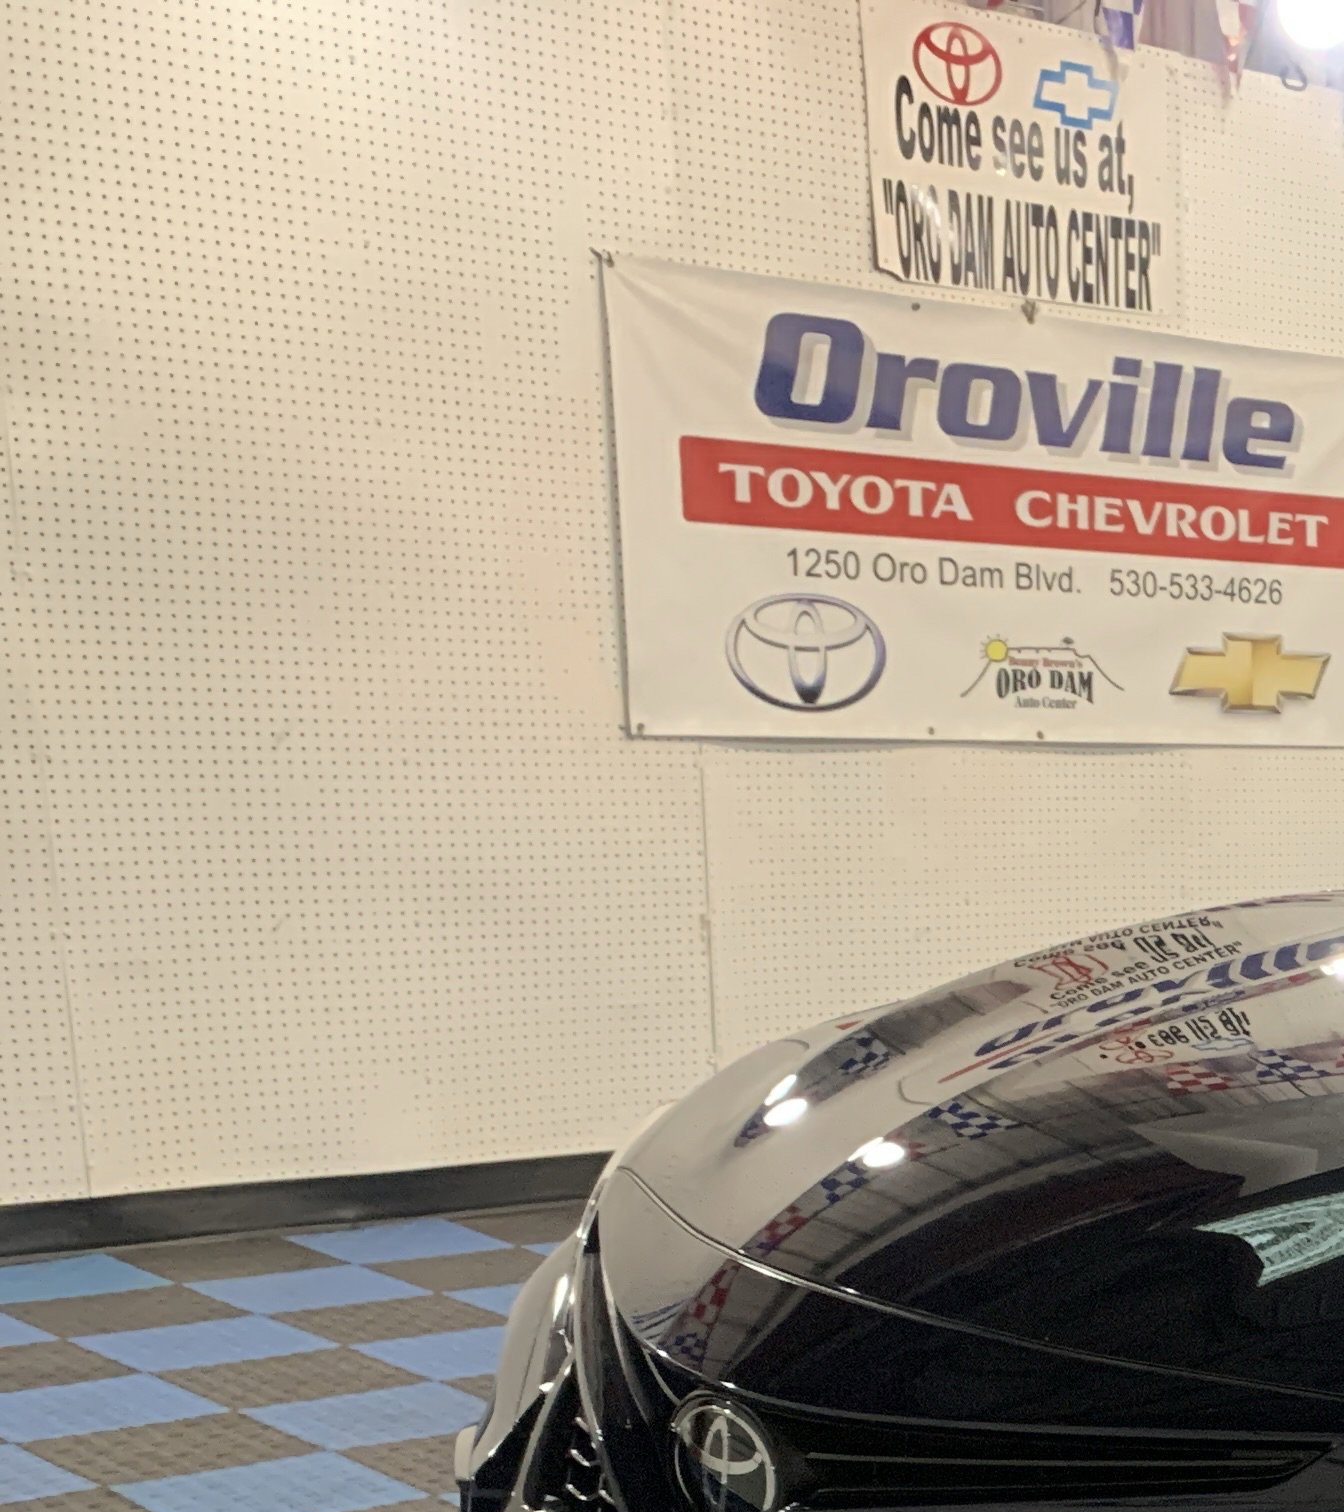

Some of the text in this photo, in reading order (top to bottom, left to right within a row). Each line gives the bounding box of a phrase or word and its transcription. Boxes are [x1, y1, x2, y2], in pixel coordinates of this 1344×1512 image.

[895, 75, 1135, 214] Come see us at,
[948, 189, 995, 290] DAM
[1003, 199, 1060, 300] AUTO
[1067, 208, 1161, 312] CENTER"
[754, 312, 1298, 470] Oroville
[718, 462, 1329, 548] TOYOTA CHEVROLET
[785, 547, 1284, 605] 1250 Oro Dam Blvd. 530-533-4626
[996, 668, 1094, 704] ORO DAM
[1015, 696, 1077, 709] Auto Center
